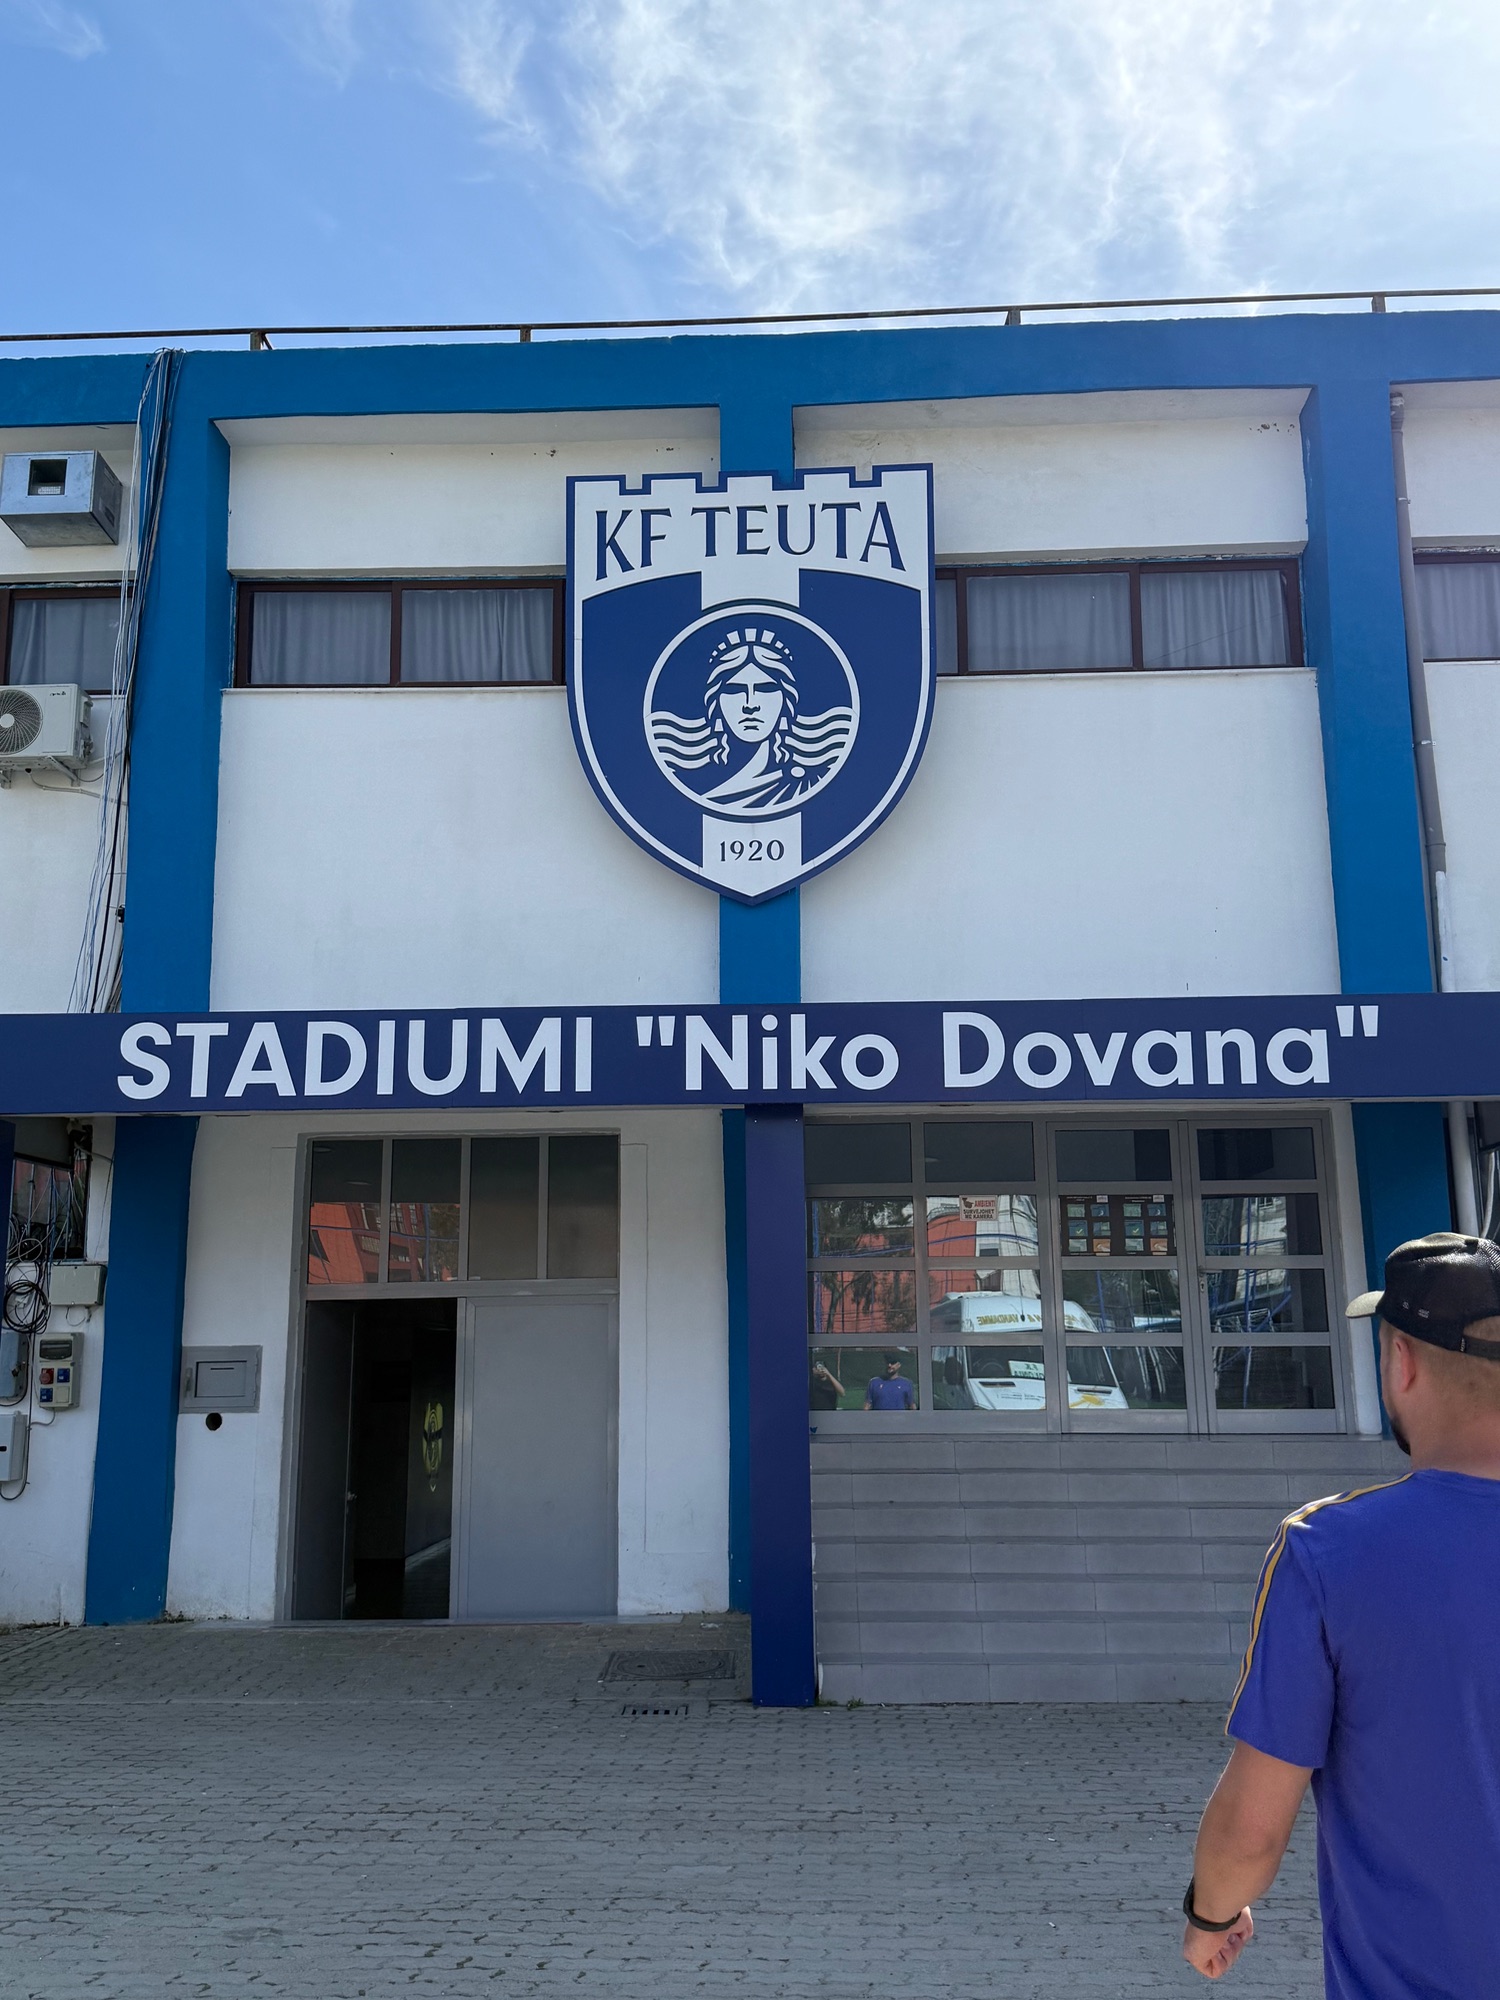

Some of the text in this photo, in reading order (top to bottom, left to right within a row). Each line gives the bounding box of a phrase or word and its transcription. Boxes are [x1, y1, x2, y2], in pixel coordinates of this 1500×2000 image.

[595, 501, 907, 582] KF TEUTA
[719, 839, 786, 863] 1920
[116, 1005, 1380, 1100] STADIUMI "Niko Dovana"
